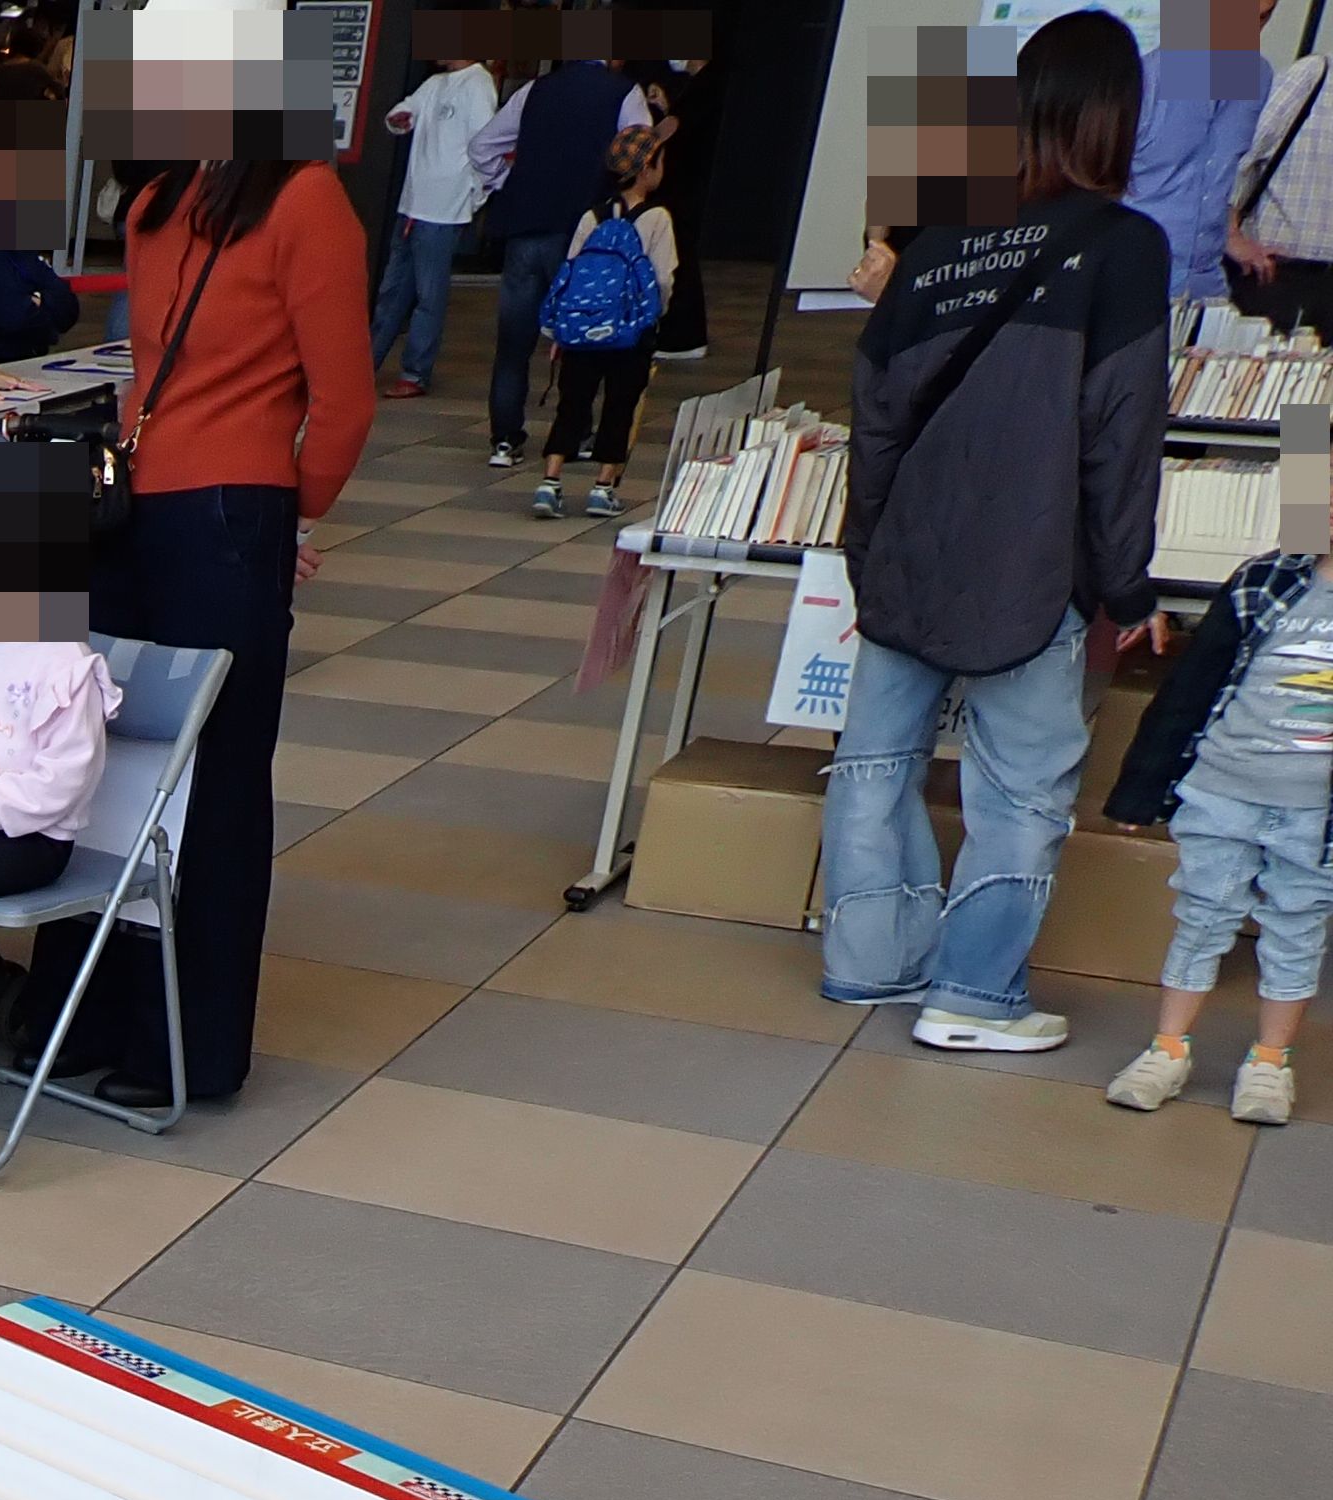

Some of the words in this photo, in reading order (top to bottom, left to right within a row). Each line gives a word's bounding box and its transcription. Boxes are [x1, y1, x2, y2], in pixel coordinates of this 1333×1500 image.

[343, 91, 353, 107] 2
[961, 232, 997, 256] THE
[1000, 225, 1048, 246] SEED
[795, 653, 850, 715] 無
[233, 1404, 343, 1456] 立入禁止
